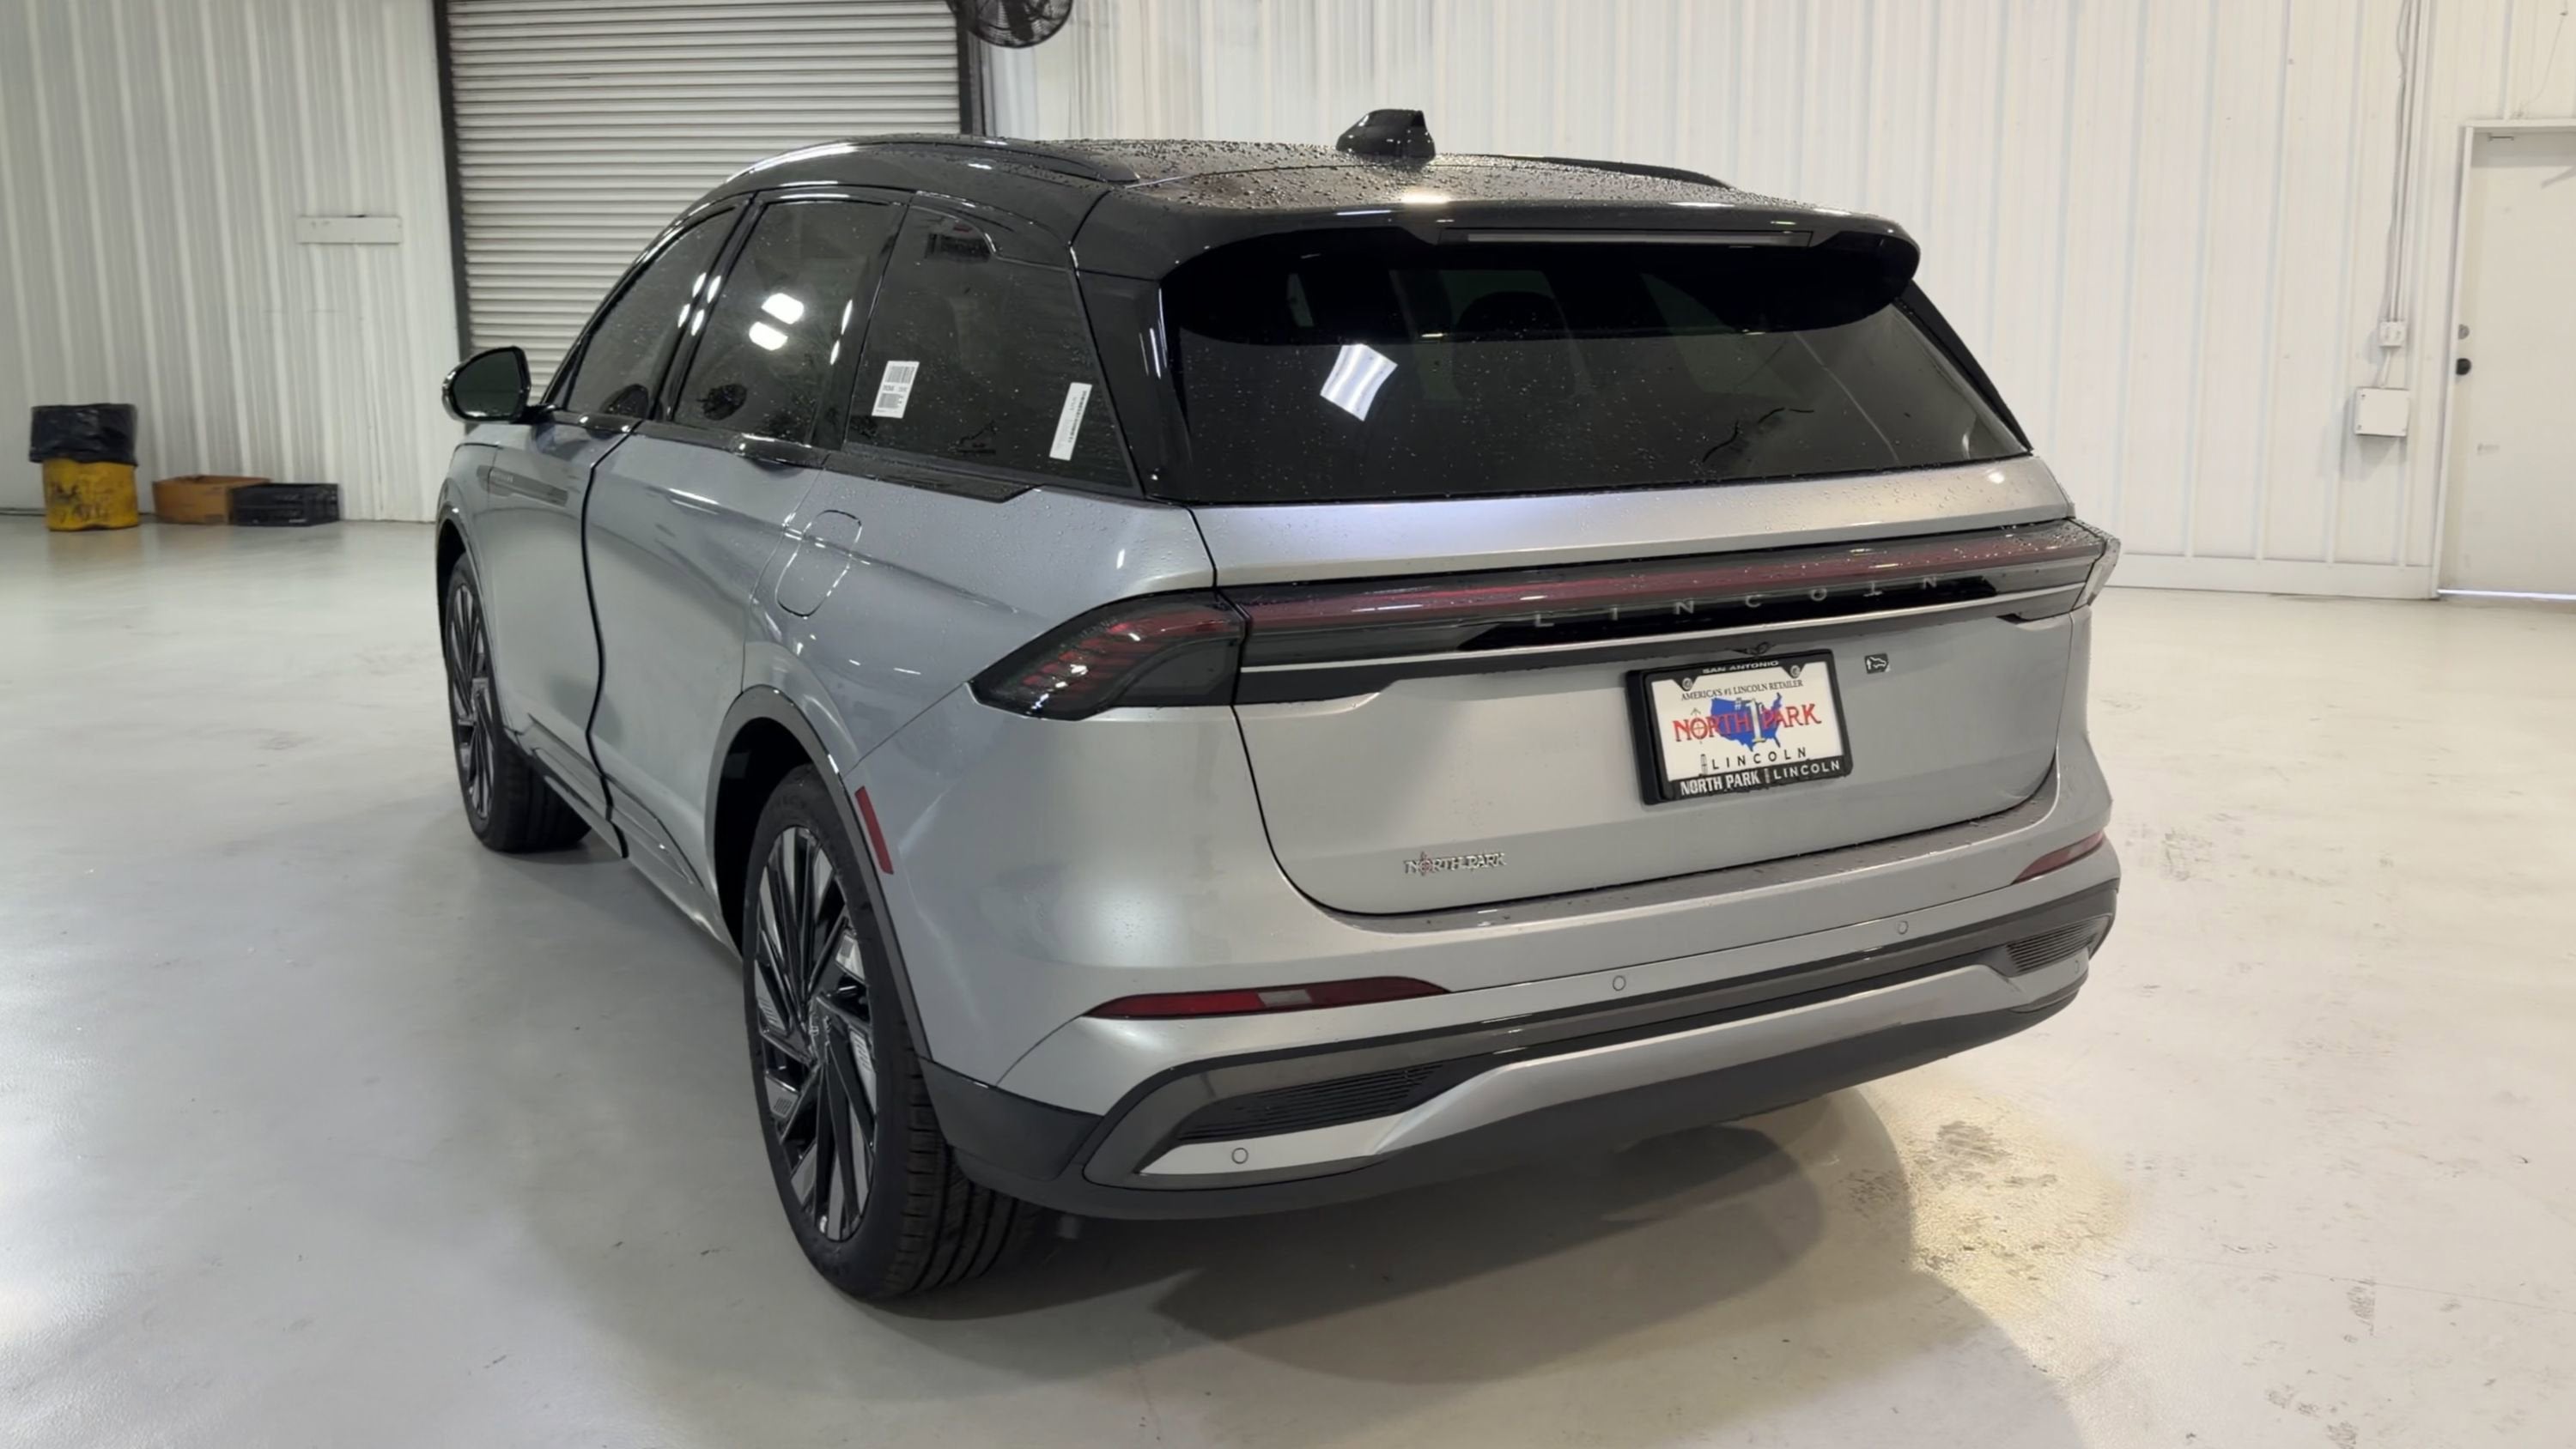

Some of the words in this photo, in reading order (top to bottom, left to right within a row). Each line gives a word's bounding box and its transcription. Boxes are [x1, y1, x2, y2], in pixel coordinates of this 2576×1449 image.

[1534, 575, 1938, 628] LINCOLN
[1729, 660, 1779, 671] ANTONIO
[1681, 688, 1722, 701] AMERICA'S
[1724, 688, 1732, 696] #1
[1734, 683, 1768, 695] LINCOLN
[1770, 679, 1804, 691] RETAILER
[1673, 712, 1752, 742] NORTH
[1763, 703, 1822, 730] PARK
[1711, 747, 1807, 770] LINCOLN
[1680, 774, 1722, 796] NORTH
[1724, 770, 1760, 789] PARK
[1773, 760, 1840, 779] LINCOLN
[1403, 858, 1461, 875] NORTH
[1465, 852, 1508, 870] PARK
